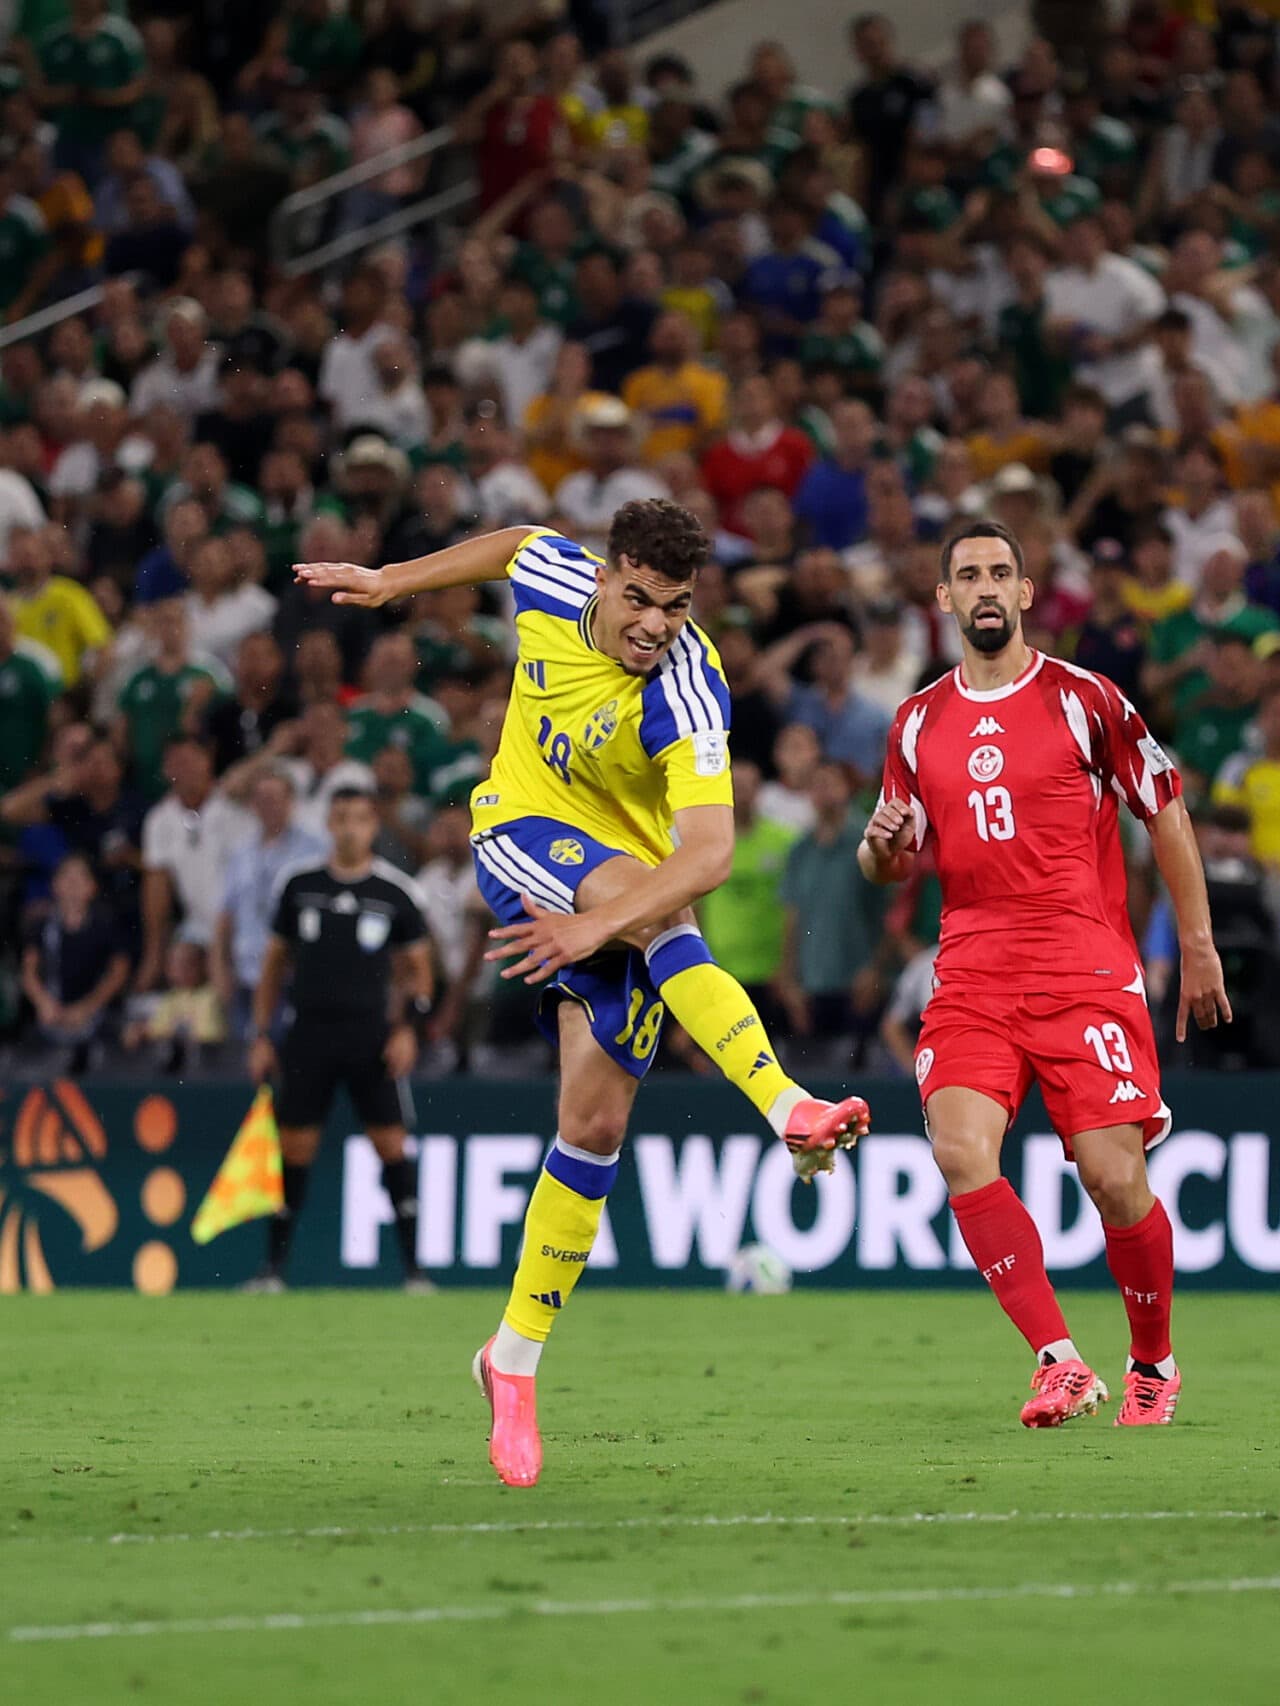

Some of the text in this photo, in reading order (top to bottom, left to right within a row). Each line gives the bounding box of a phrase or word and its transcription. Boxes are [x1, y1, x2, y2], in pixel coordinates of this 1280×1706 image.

[538, 715, 571, 785] 18
[967, 786, 1015, 842] 13
[615, 988, 664, 1059] 18
[1084, 1022, 1133, 1072] 13
[340, 1134, 620, 1268] FIF
[983, 1254, 1016, 1282] FTF
[1124, 1286, 1158, 1304] FTF
